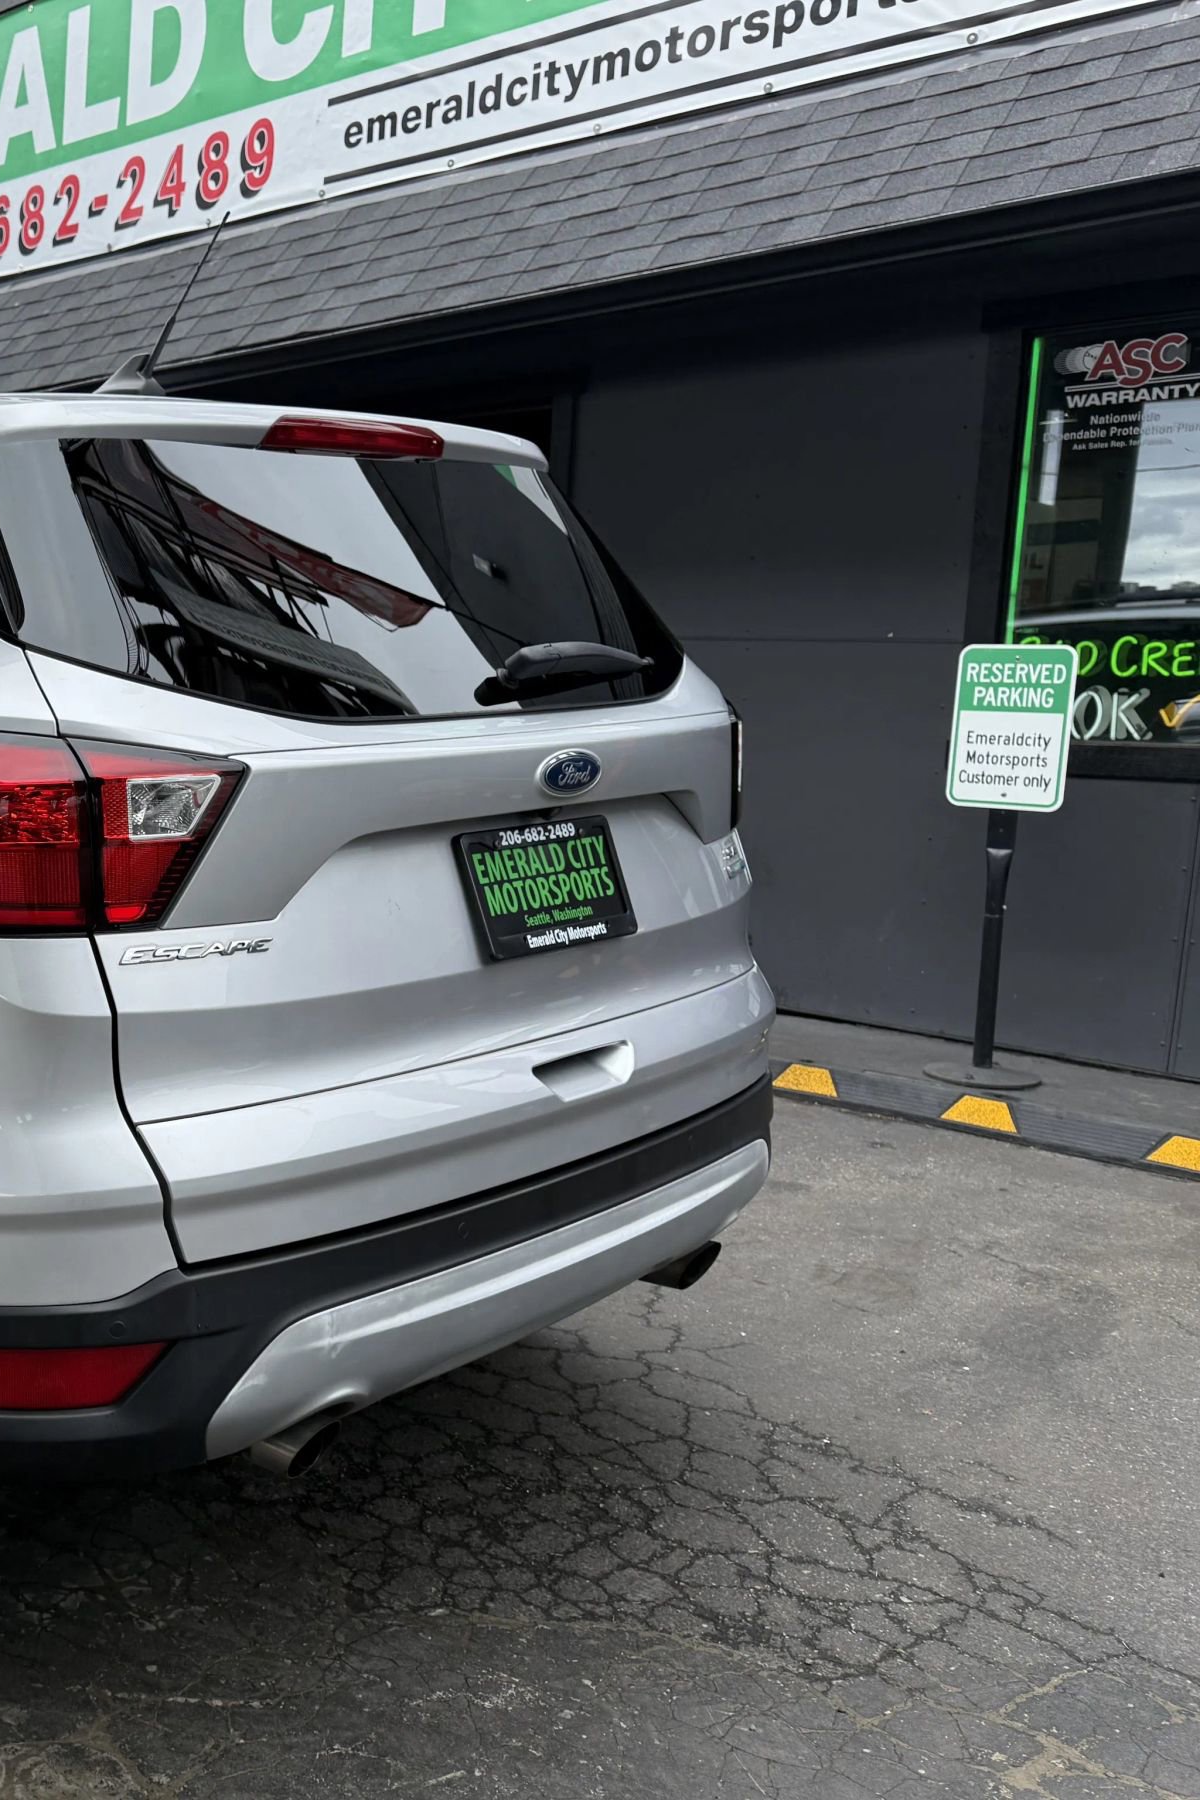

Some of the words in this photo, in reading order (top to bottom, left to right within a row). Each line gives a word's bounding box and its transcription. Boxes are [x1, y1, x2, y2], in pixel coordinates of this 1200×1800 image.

[343, 0, 918, 149] emeraldcitymotorspo
[1084, 333, 1188, 388] ASC
[1066, 383, 1200, 409] WARRANTY
[966, 663, 1067, 684] RESERVED
[973, 686, 1055, 708] PARKING
[1071, 690, 1142, 741] OK
[967, 730, 1052, 752] Emeraldcity
[966, 750, 1048, 770] Motorsports
[558, 761, 592, 786] Ford
[959, 769, 1019, 786] Customer
[1023, 774, 1052, 792] only
[499, 822, 576, 846] 206-682-2489
[472, 843, 566, 885] EMERALD
[566, 835, 607, 869] CITY
[483, 866, 615, 917] MOTORSPORTS
[524, 912, 554, 928] Seattle,
[552, 905, 594, 923] Washington
[526, 930, 554, 949] Emerald
[553, 928, 569, 946] City
[567, 921, 608, 940] Motorsports
[118, 938, 274, 966] ESCAPE
